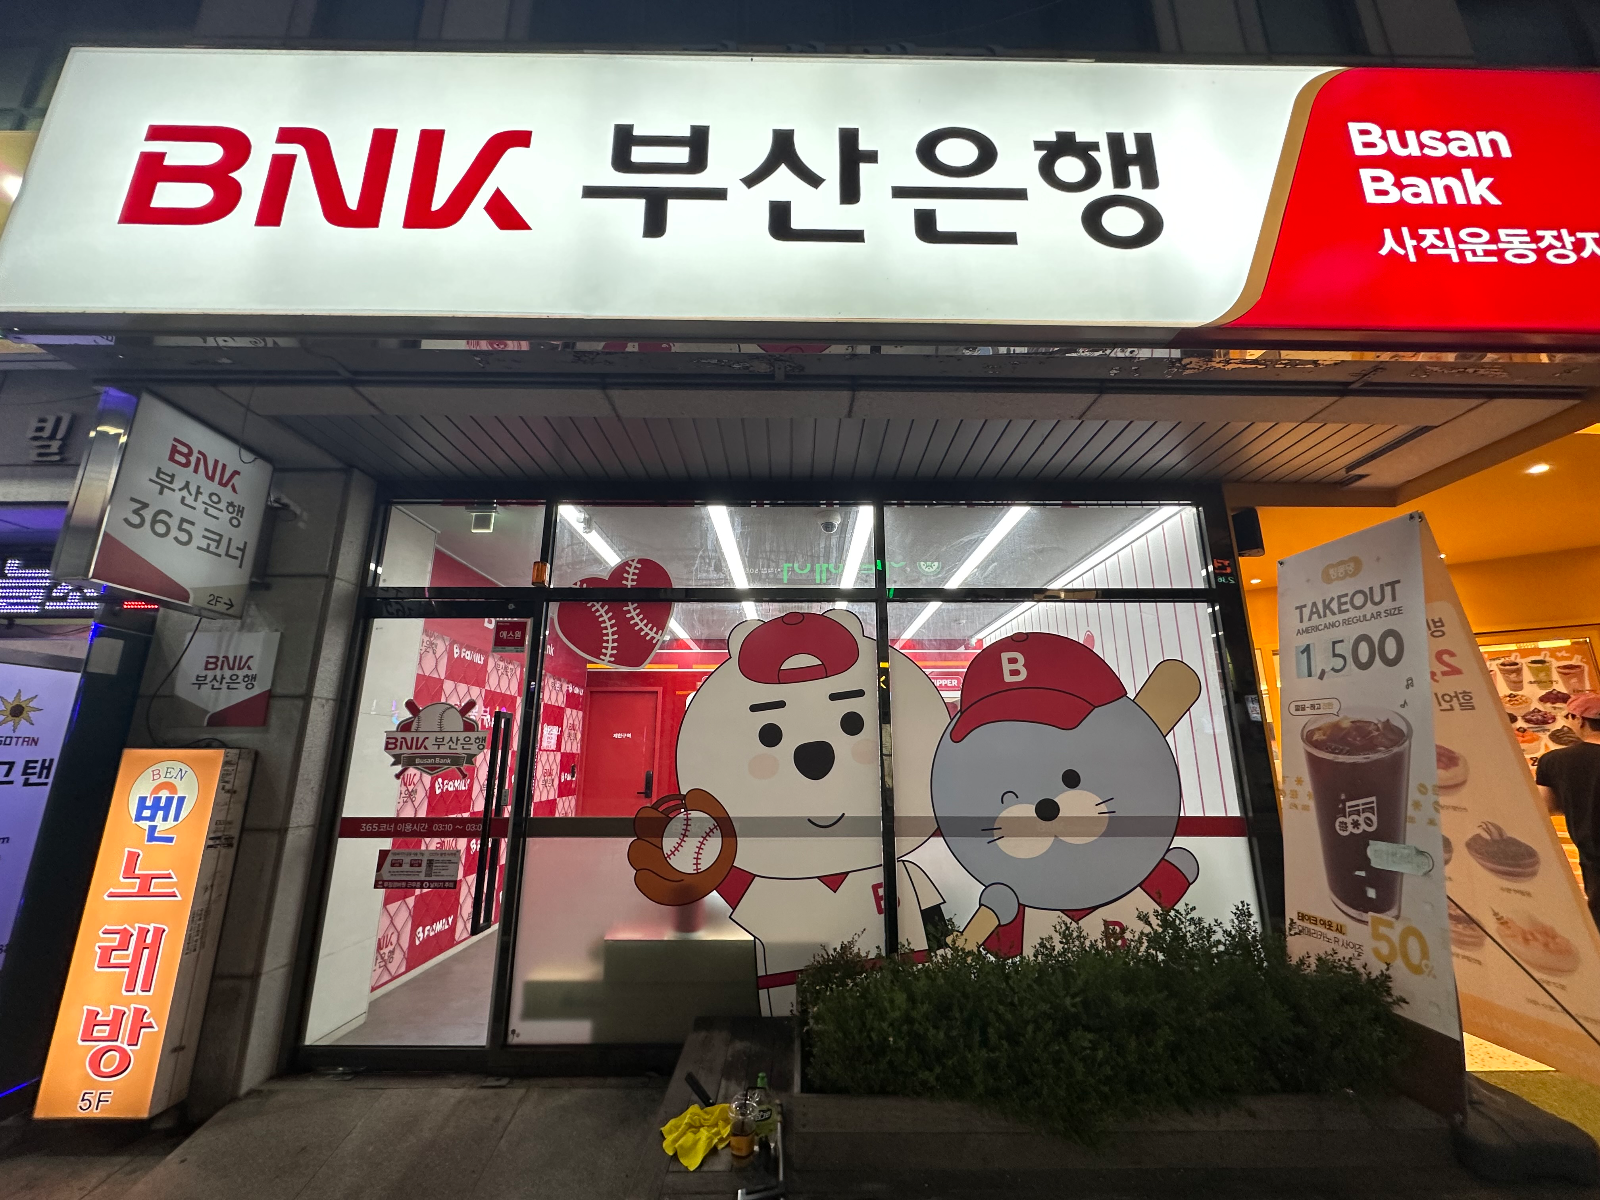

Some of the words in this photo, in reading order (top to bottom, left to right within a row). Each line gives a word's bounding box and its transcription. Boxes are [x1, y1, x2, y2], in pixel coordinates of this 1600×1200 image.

[1347, 121, 1513, 158] Busan
[117, 124, 533, 230] BNK
[581, 123, 1164, 250] 부산은행
[1358, 168, 1502, 206] Bank
[167, 436, 241, 495] BNK
[149, 466, 245, 529] 부산은행
[122, 496, 248, 569] 365코너
[206, 593, 222, 608] 2F
[1295, 579, 1401, 624] TAKEOUT
[1295, 618, 1341, 637] AMERICANO
[1341, 610, 1383, 626] REGULAR
[1384, 605, 1404, 618] SIZE
[204, 655, 254, 672] BNK
[1000, 651, 1028, 682] B
[1299, 628, 1405, 681] 1,500
[191, 673, 258, 691] 부산은행
[385, 736, 430, 751] BNK
[432, 736, 487, 751] 부산은행
[151, 766, 188, 782] BEN
[360, 822, 395, 832] 365코너
[397, 822, 429, 833] 이용시간
[432, 823, 453, 832] 03:10
[465, 823, 483, 832] 03:0
[1296, 911, 1318, 926] 테이크
[1298, 924, 1333, 944] 아메리카노
[78, 1090, 113, 1112] 5F
